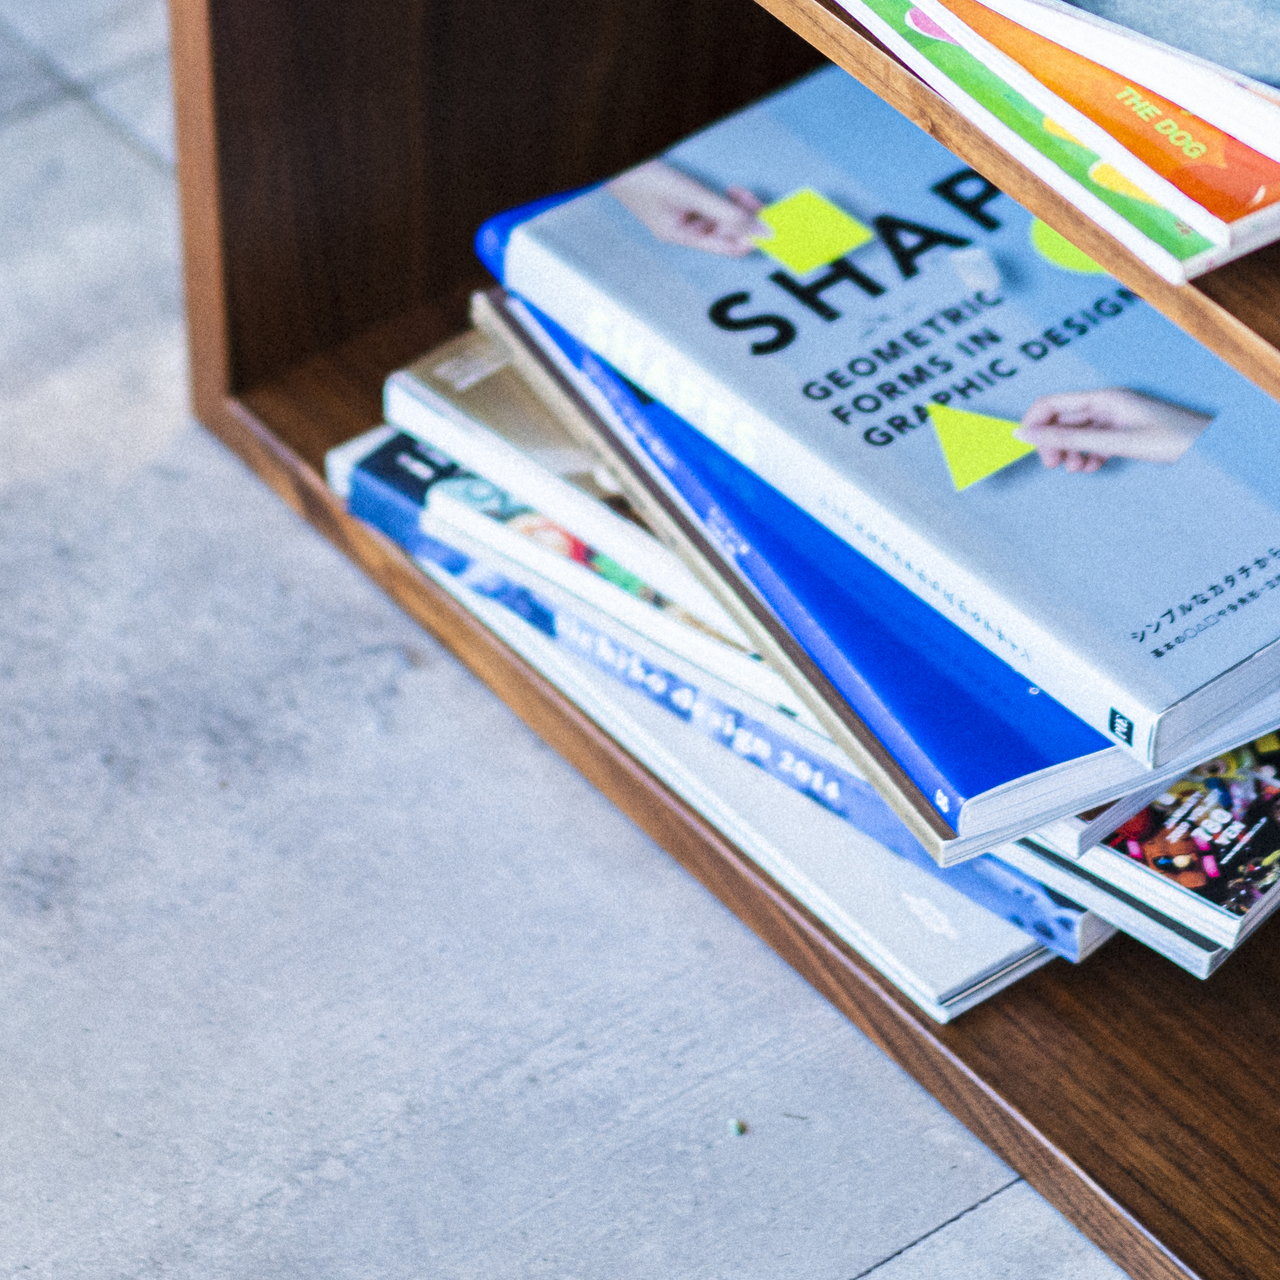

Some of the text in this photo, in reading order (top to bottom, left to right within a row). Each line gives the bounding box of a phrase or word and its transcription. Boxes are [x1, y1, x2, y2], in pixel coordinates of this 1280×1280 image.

[1116, 86, 1207, 159] THE DOG
[708, 167, 1007, 358] SHAP
[802, 287, 1007, 403] GEOMETRIC
[830, 326, 1003, 427] FORMS IN
[863, 354, 1019, 448] GRAPHIC
